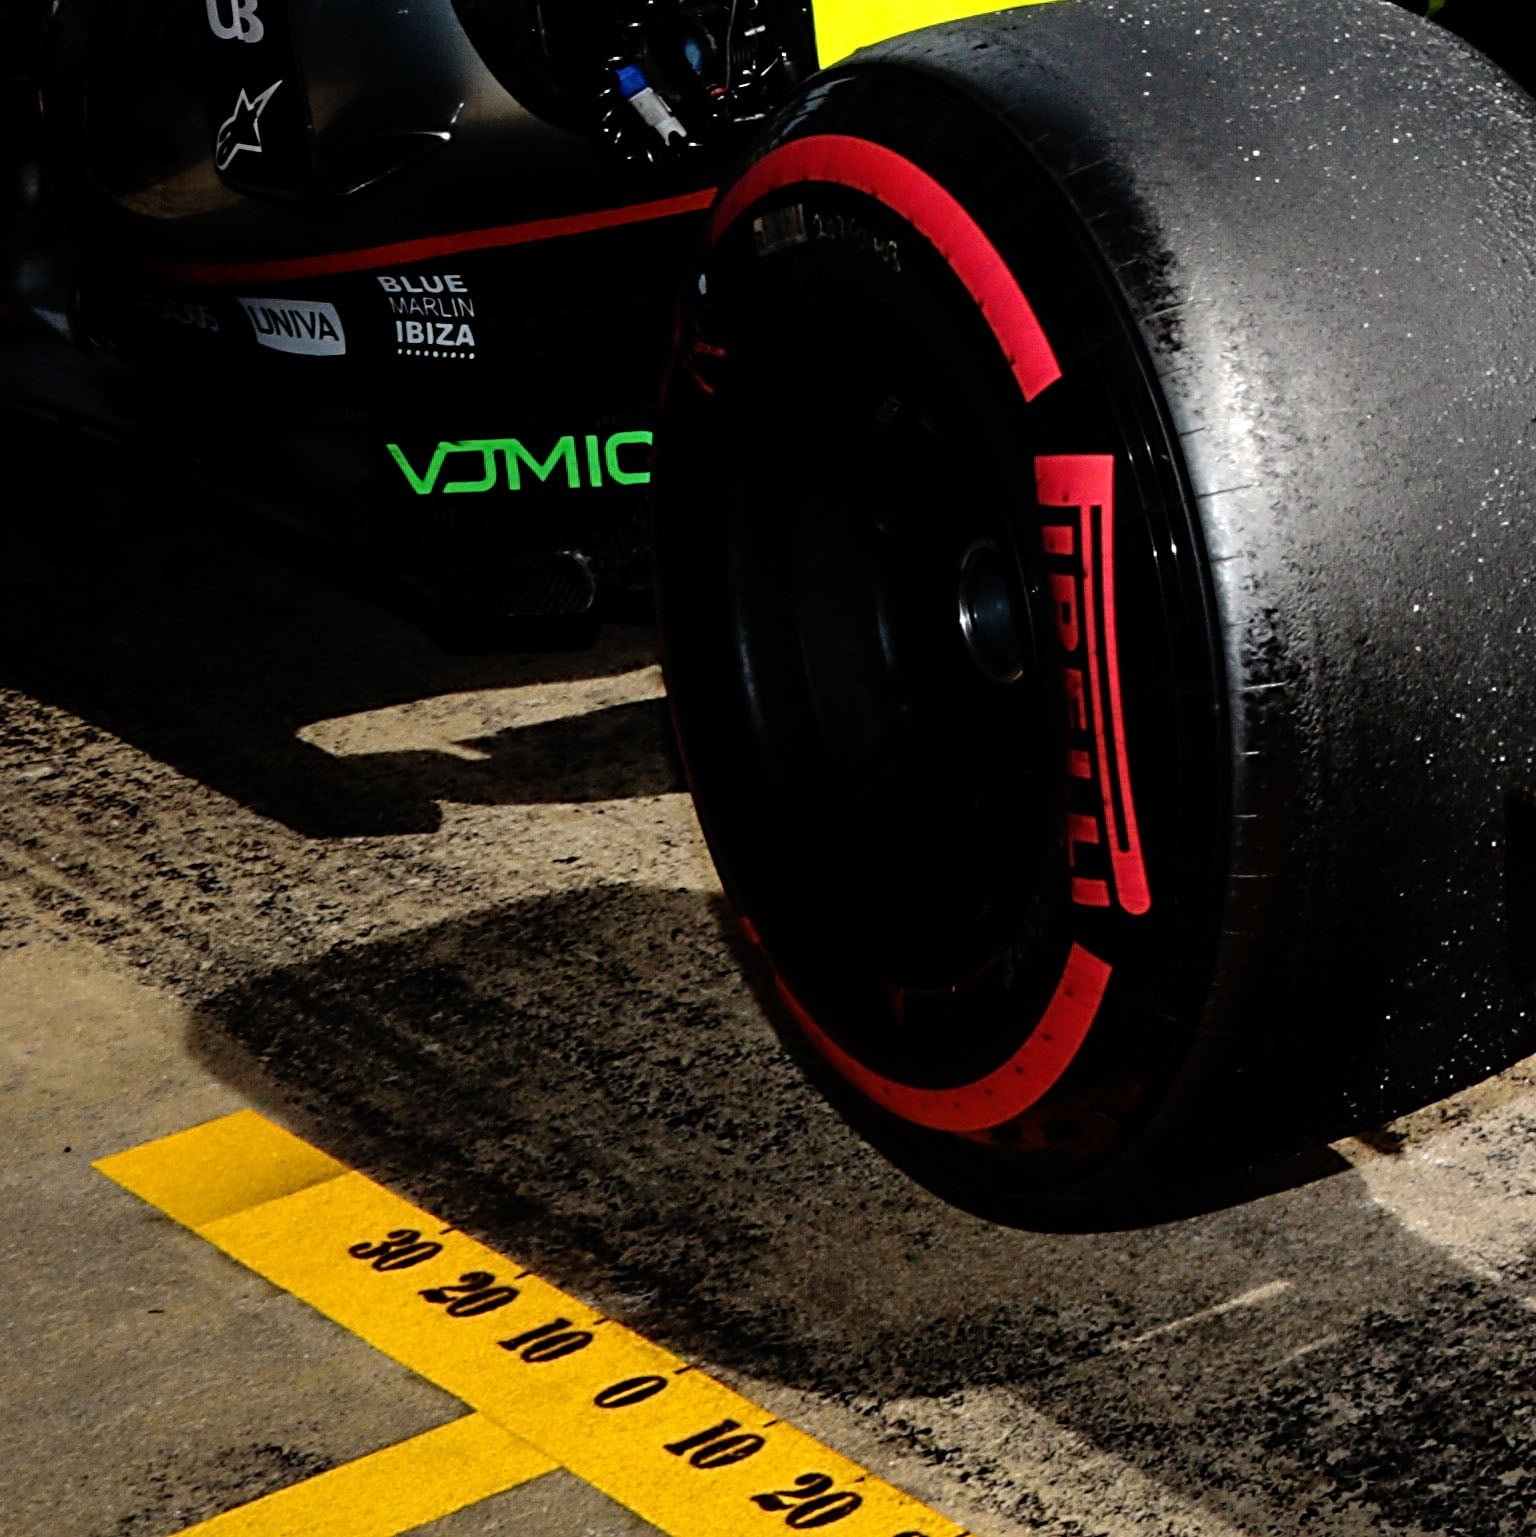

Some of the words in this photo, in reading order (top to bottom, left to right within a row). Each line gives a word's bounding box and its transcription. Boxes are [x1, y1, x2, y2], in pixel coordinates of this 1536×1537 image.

[376, 274, 470, 295] BLUE
[388, 295, 476, 319] MARLIN
[246, 305, 341, 343] UNIVA
[394, 319, 477, 348] IBIZA
[1034, 453, 1152, 916] PIRELLI
[347, 1226, 447, 1274] 30
[420, 1269, 524, 1318] 20
[498, 1316, 596, 1365] 10
[593, 1372, 669, 1412] 0
[664, 1416, 768, 1473] 10
[751, 1471, 865, 1531] 20
